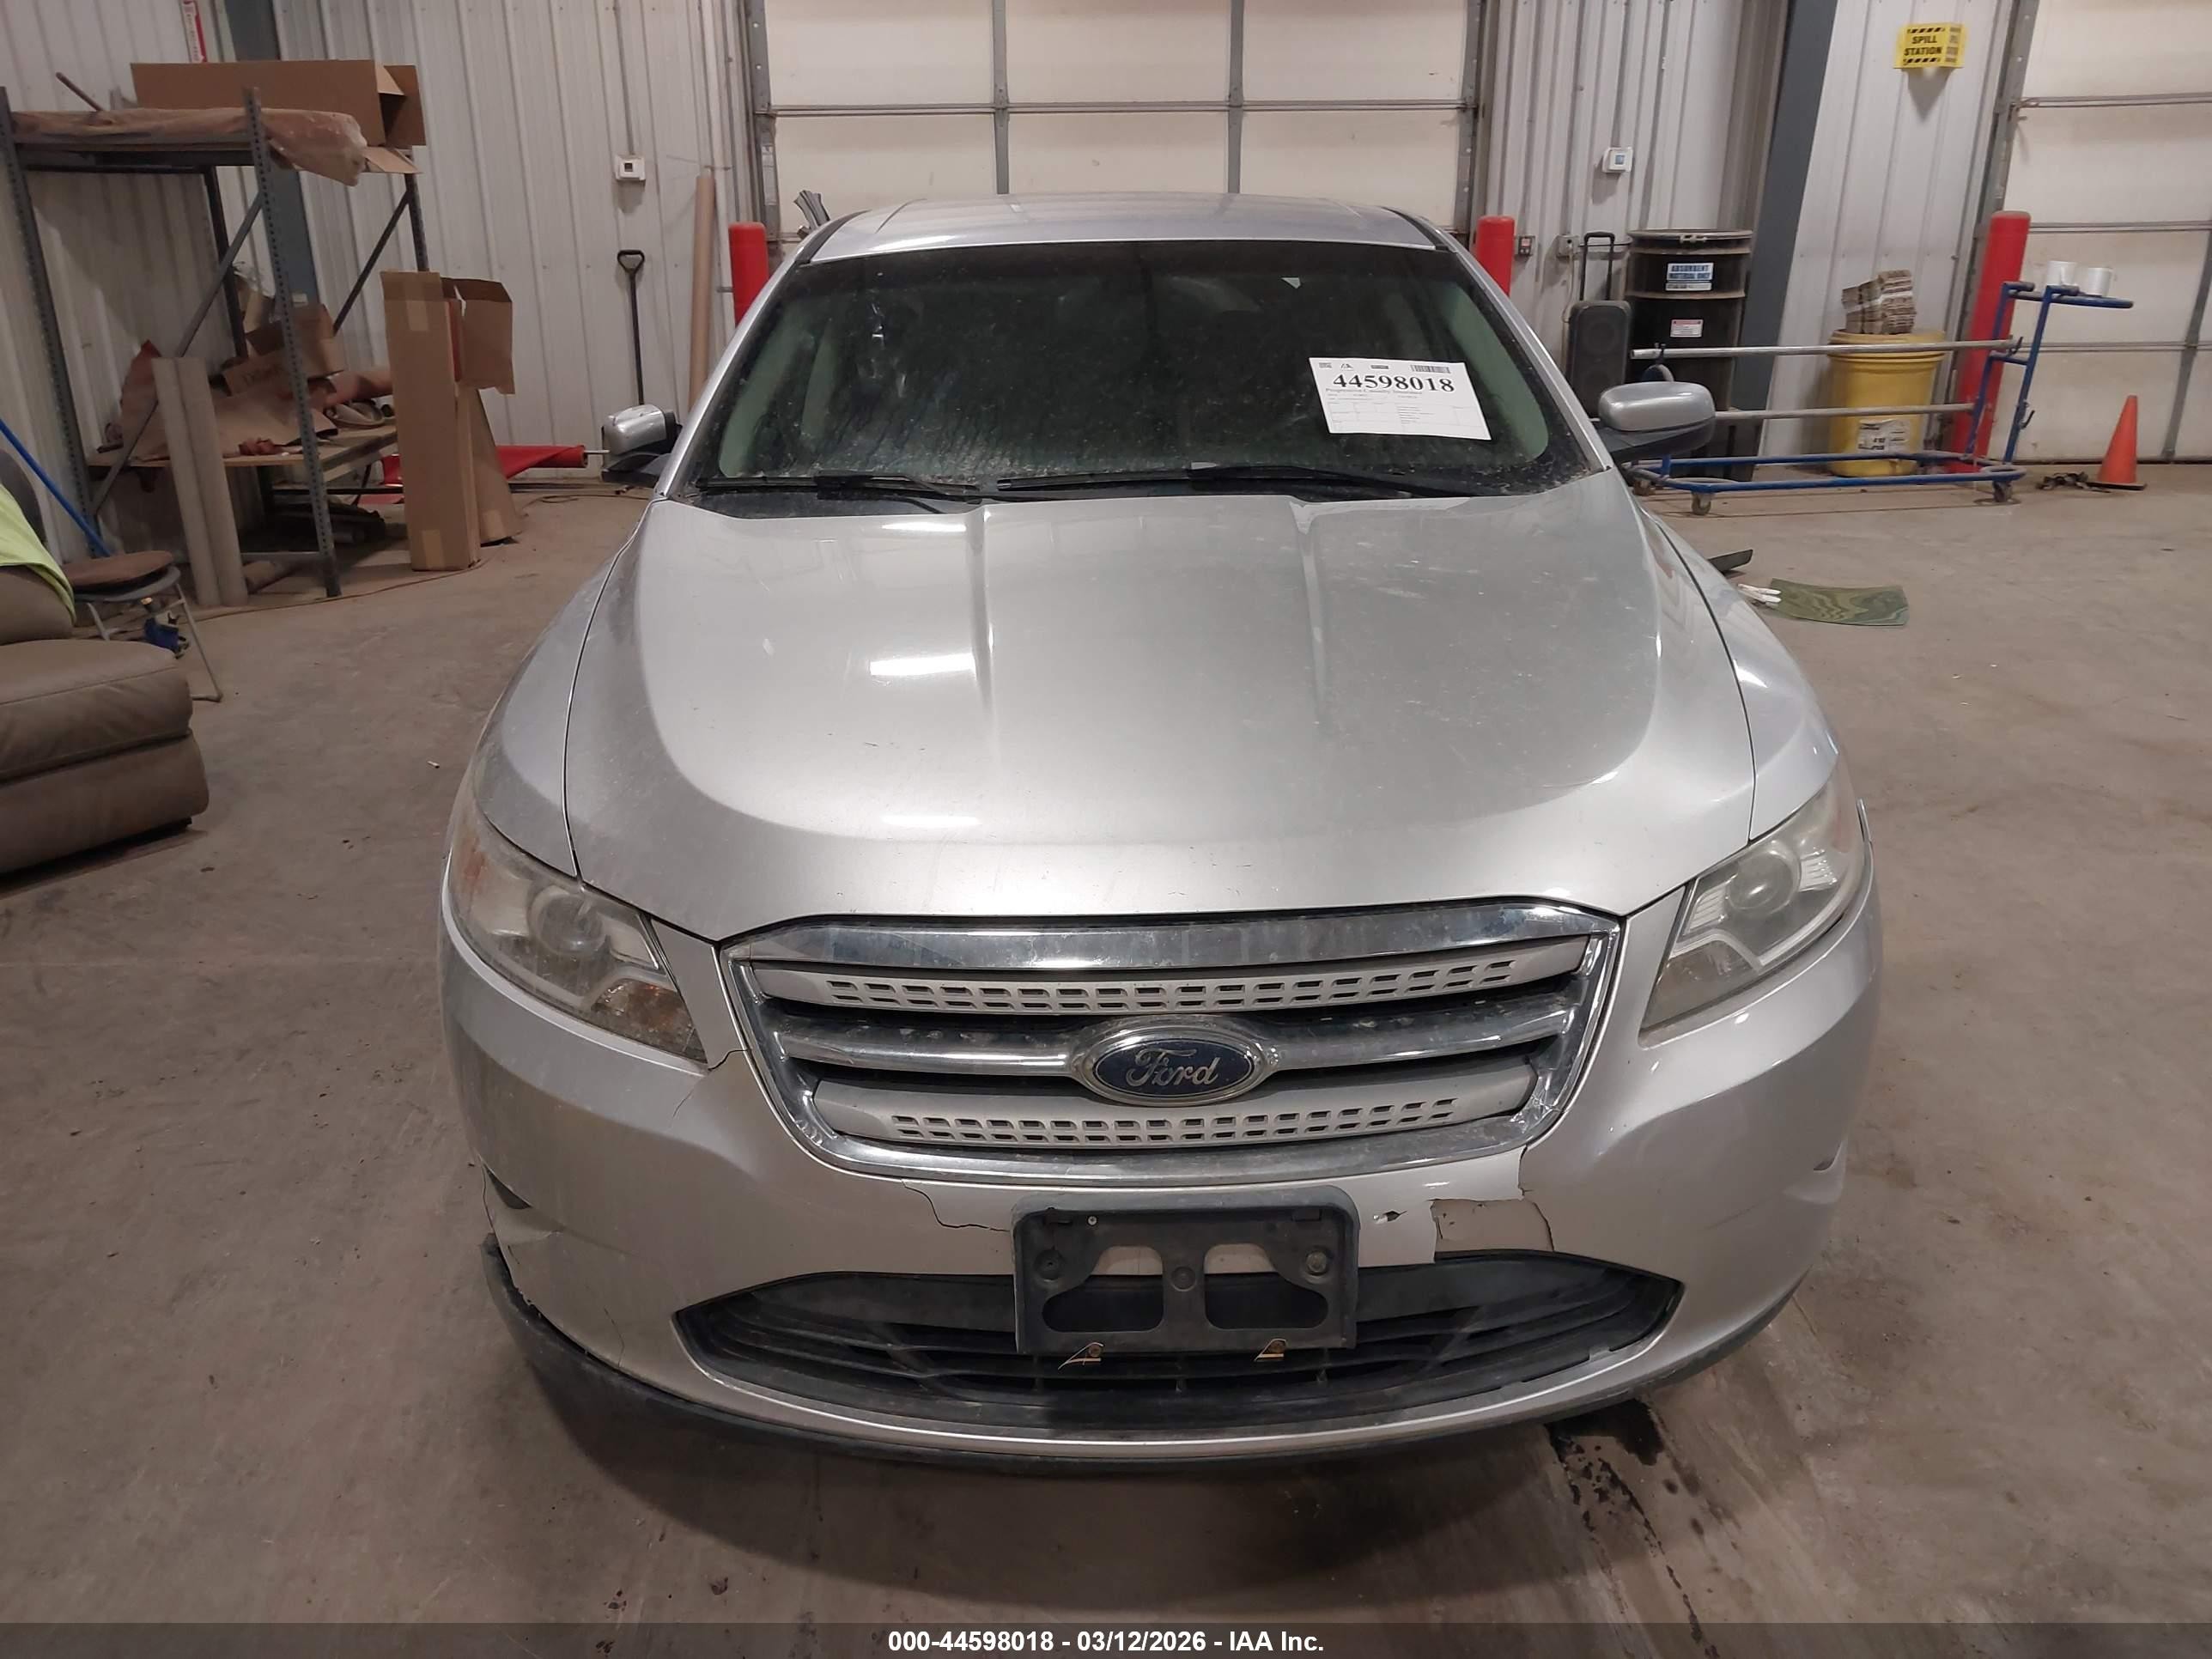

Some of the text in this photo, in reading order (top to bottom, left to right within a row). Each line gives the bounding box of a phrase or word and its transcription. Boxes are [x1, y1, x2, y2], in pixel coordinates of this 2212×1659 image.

[1911, 35, 1937, 44] SPILL
[1904, 46, 1942, 56] STATION
[1333, 374, 1455, 392] 44598018
[1126, 1048, 1221, 1086] Ford
